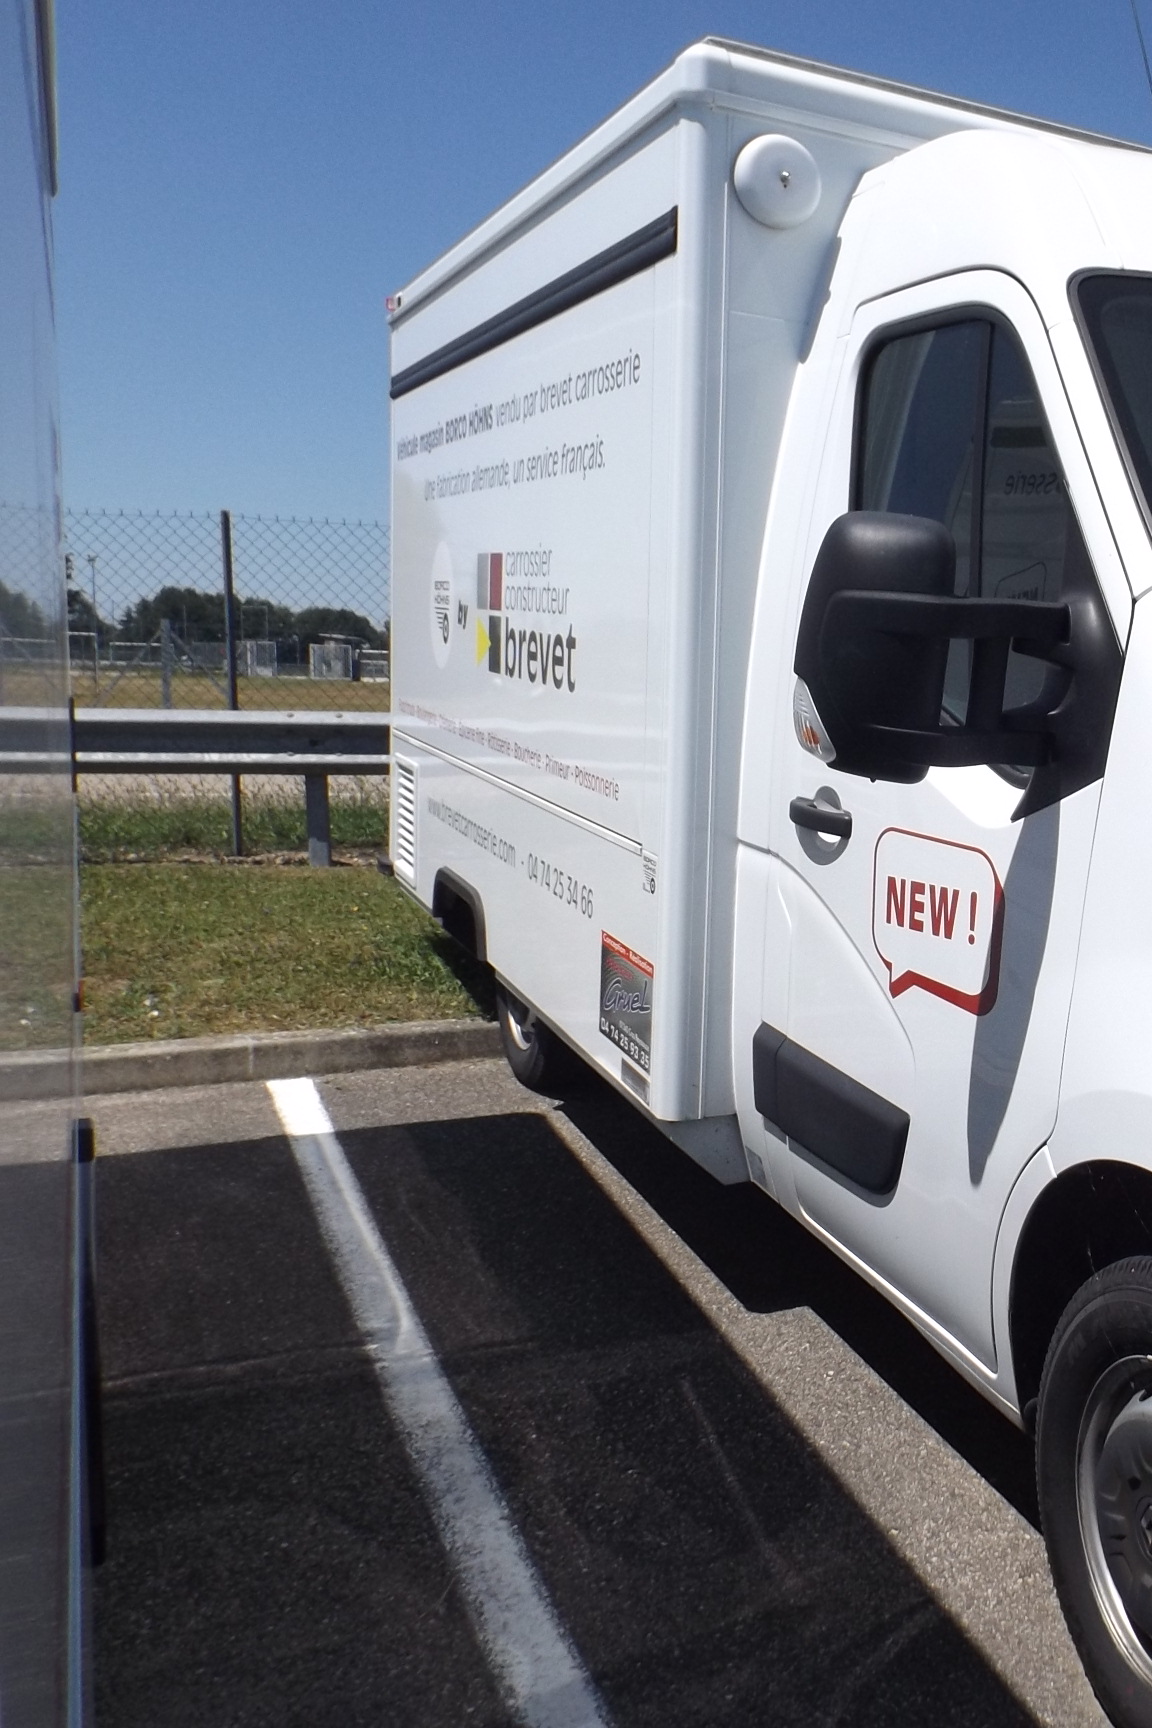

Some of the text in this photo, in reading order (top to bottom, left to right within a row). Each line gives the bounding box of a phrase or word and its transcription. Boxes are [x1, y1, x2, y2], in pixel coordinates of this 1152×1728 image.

[445, 413, 467, 444] BORCO
[495, 393, 521, 427] vendu
[523, 389, 538, 424] par
[540, 373, 573, 413] brevet
[575, 347, 641, 402] carrosserie
[513, 458, 525, 484] un
[526, 446, 559, 482] service
[561, 433, 606, 481] français.
[505, 543, 553, 577] carrossier
[457, 600, 469, 630] by
[505, 585, 570, 615] constructeur
[504, 616, 577, 693] brevet
[574, 765, 620, 802] Poissonnerie
[527, 853, 539, 884] 04
[540, 860, 551, 892] 74
[553, 867, 565, 900] 25
[566, 876, 579, 909] 34
[581, 885, 594, 919] 66
[885, 876, 960, 940] NEW
[600, 1016, 610, 1034] 04
[610, 1024, 619, 1042] 74
[620, 1033, 629, 1051] 25
